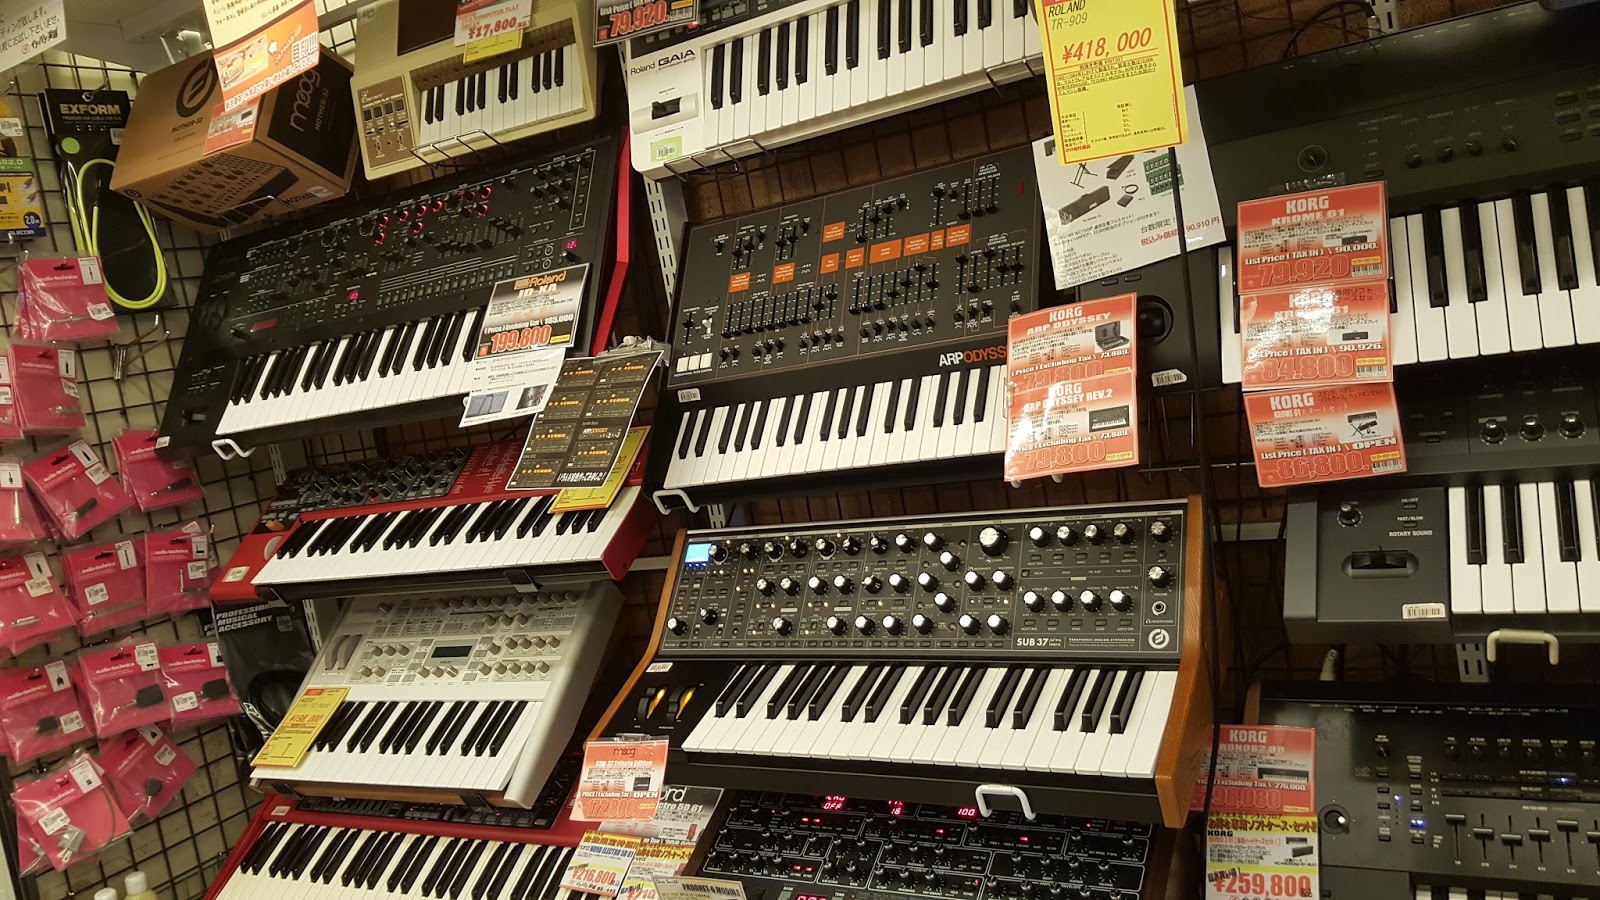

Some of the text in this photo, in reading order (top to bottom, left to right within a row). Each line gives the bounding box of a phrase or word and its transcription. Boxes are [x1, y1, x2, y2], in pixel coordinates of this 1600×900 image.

[1048, 0, 1086, 18] ROLAND
[468, 16, 517, 39] ¥17,800
[1051, 12, 1088, 31] TR-909
[630, 49, 696, 76] Roland GAIA
[59, 103, 121, 115] EXFORM
[1285, 195, 1329, 214] KORG
[1271, 208, 1345, 226] KROME 61
[1261, 254, 1286, 264] Price
[528, 270, 567, 287] Roland
[517, 283, 557, 299] JD-XA
[1049, 306, 1083, 323] KORG
[1027, 312, 1111, 336] ARP ODYSSEY
[939, 345, 1008, 366] ARP ODYSS
[1295, 346, 1312, 355] TAX
[1039, 358, 1077, 370] Excluding
[1078, 354, 1092, 364] Tax
[1023, 361, 1103, 384] 79800
[1086, 388, 1113, 401] REV.2
[1269, 392, 1314, 410] KORG
[130, 446, 156, 455] audio-tech
[1277, 449, 1301, 458] Price
[1308, 446, 1325, 455] TAX
[1351, 437, 1397, 450] OPEN
[1024, 441, 1106, 472] 79,800
[43, 461, 77, 482] audio-technica
[0, 571, 26, 580] -technica
[80, 561, 116, 574] audio-technica
[216, 603, 272, 620] PROFESSION
[217, 612, 258, 627] MUSICAL
[218, 615, 273, 633] ACCESSORY
[1016, 638, 1035, 647] SUB
[1036, 638, 1049, 647] 37
[95, 661, 136, 675] audio-technica
[168, 657, 206, 667] audio-technica
[1229, 729, 1268, 744] KORG
[613, 747, 636, 758] moog
[1219, 743, 1265, 753] RONOS2
[660, 786, 688, 803] ord
[691, 804, 704, 813] 61
[958, 807, 976, 815] 100
[572, 866, 617, 885] ¥216,800
[715, 887, 741, 897] MODULE
[1212, 873, 1312, 899] ¥259,800
